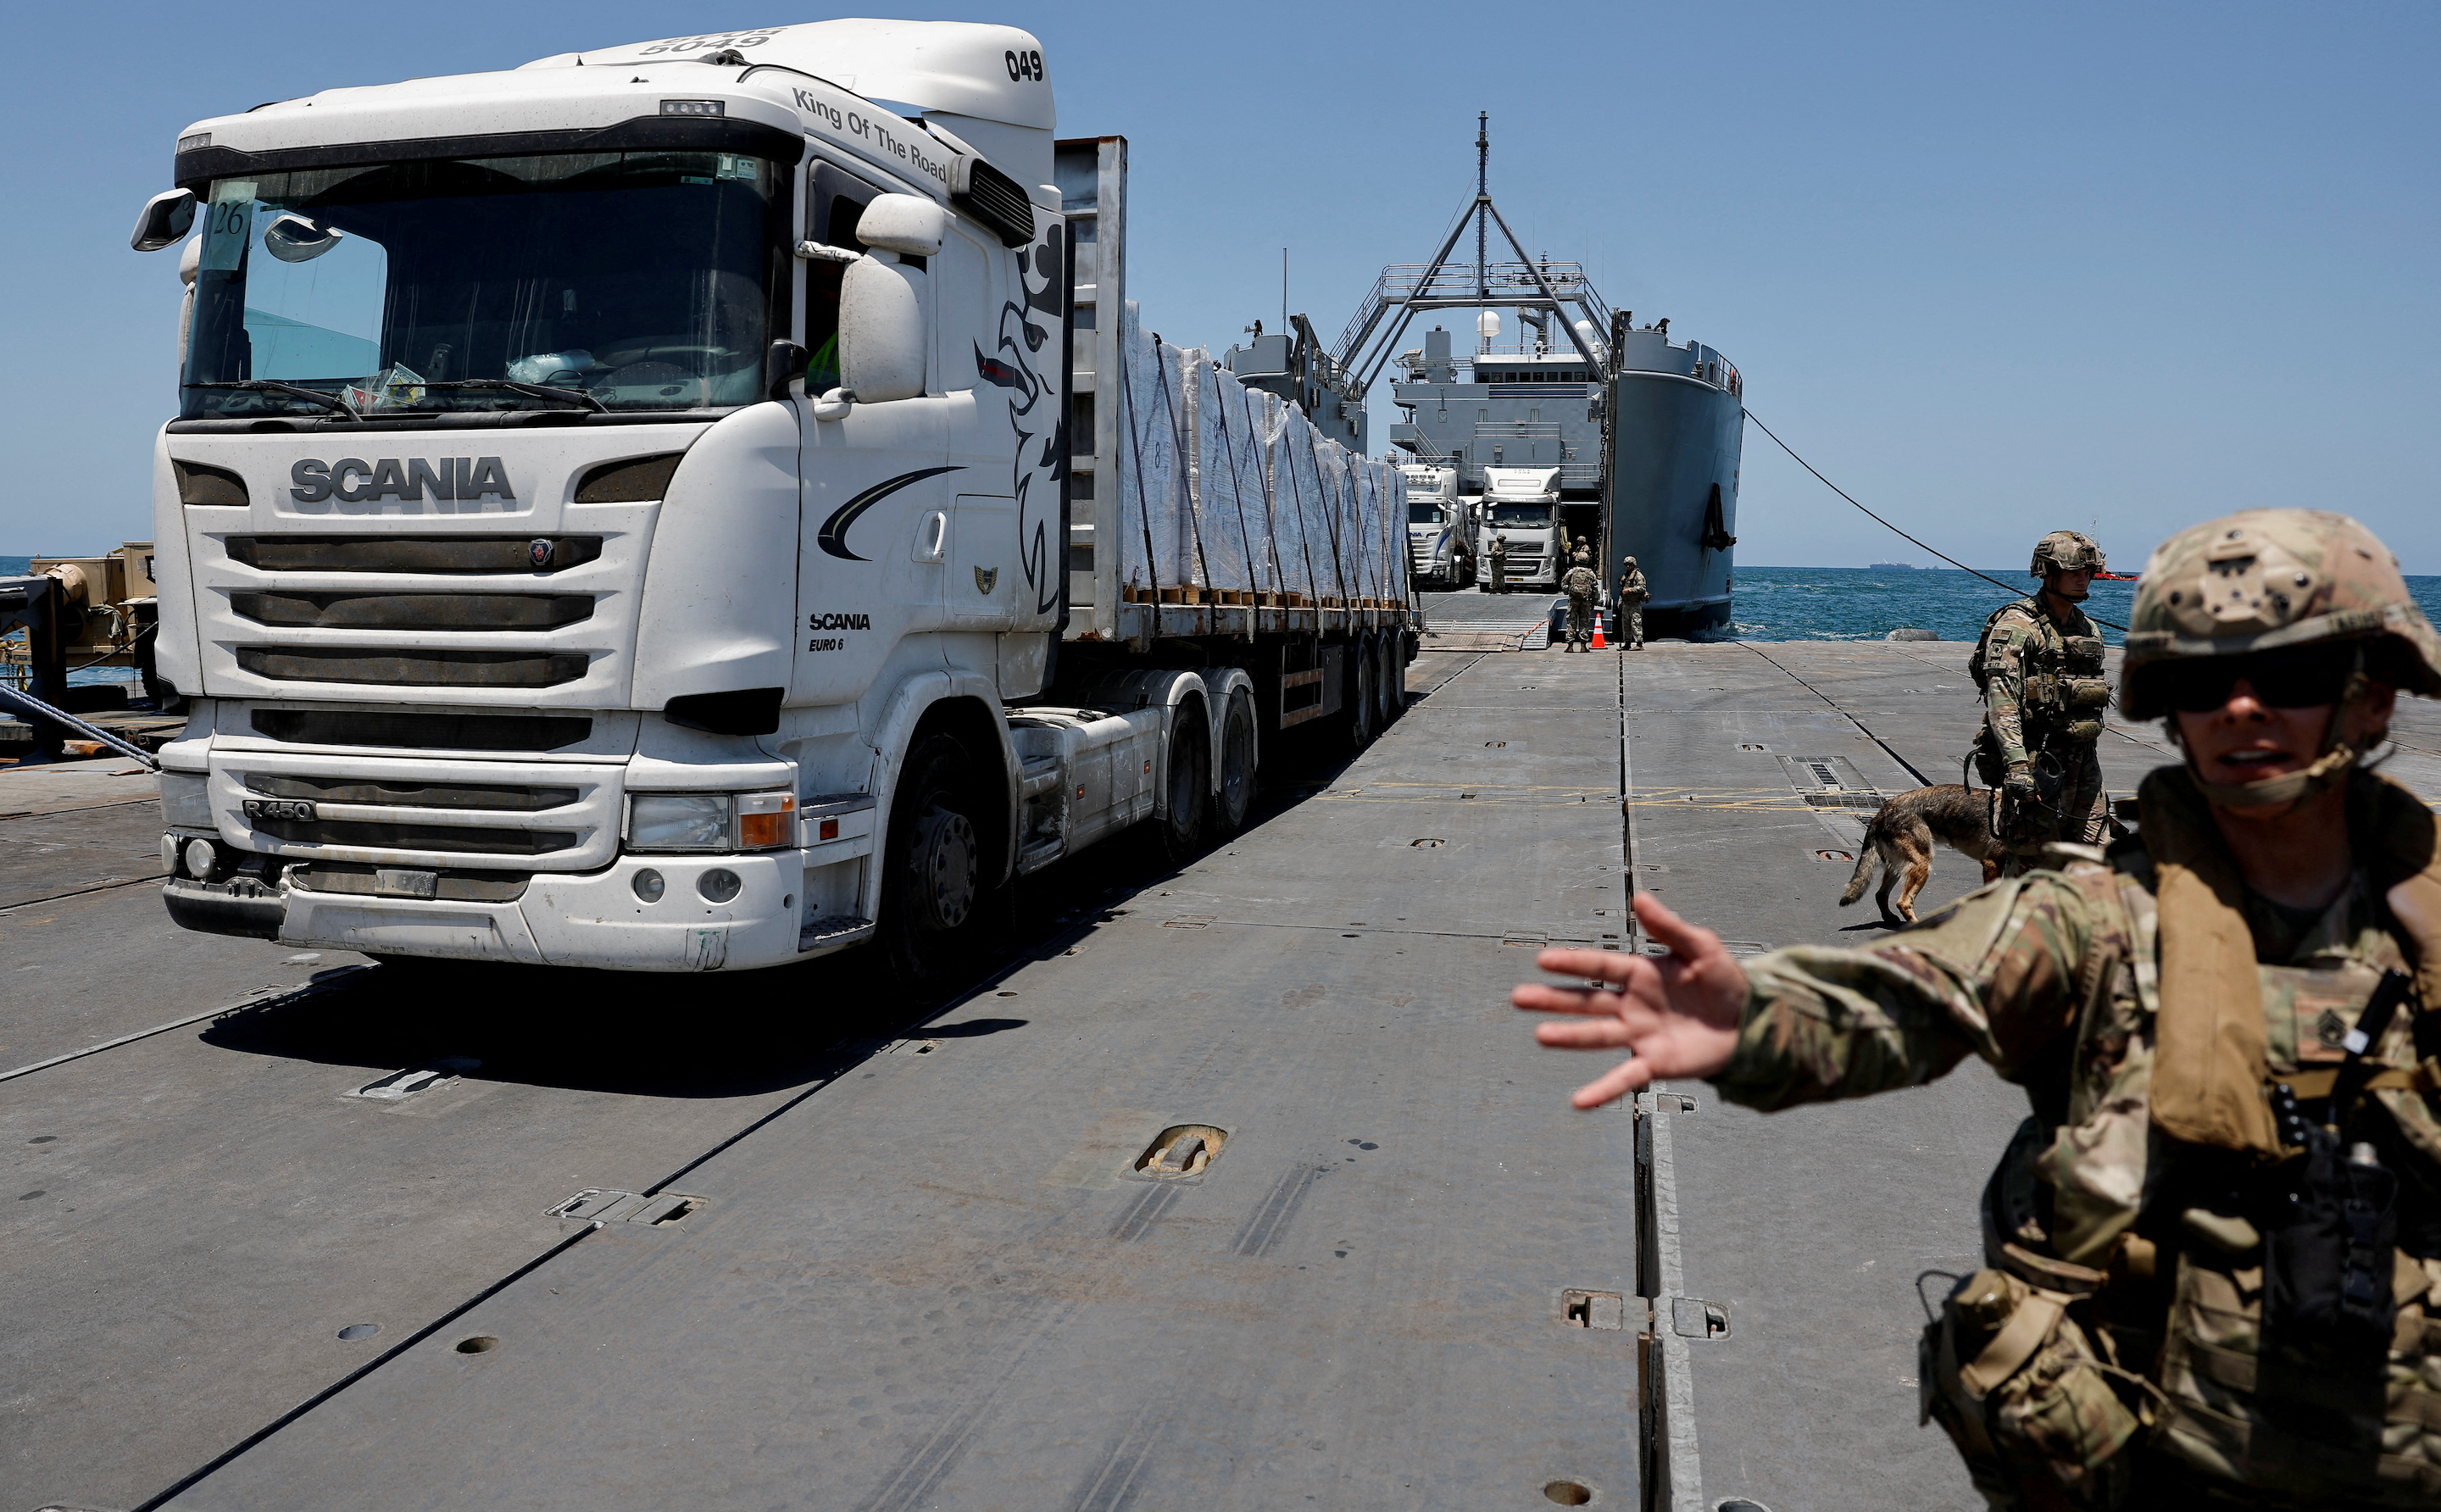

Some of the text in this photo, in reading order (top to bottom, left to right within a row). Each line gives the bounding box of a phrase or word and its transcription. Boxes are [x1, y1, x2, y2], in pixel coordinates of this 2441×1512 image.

[639, 36, 770, 55] 5049
[1004, 50, 1043, 82] 049
[792, 87, 947, 184] King Of The Road
[214, 200, 249, 235] 26
[290, 456, 516, 503] SCANIA
[809, 613, 871, 631] SCANIA
[809, 637, 844, 652] EURO 6
[245, 801, 311, 820] R 450
